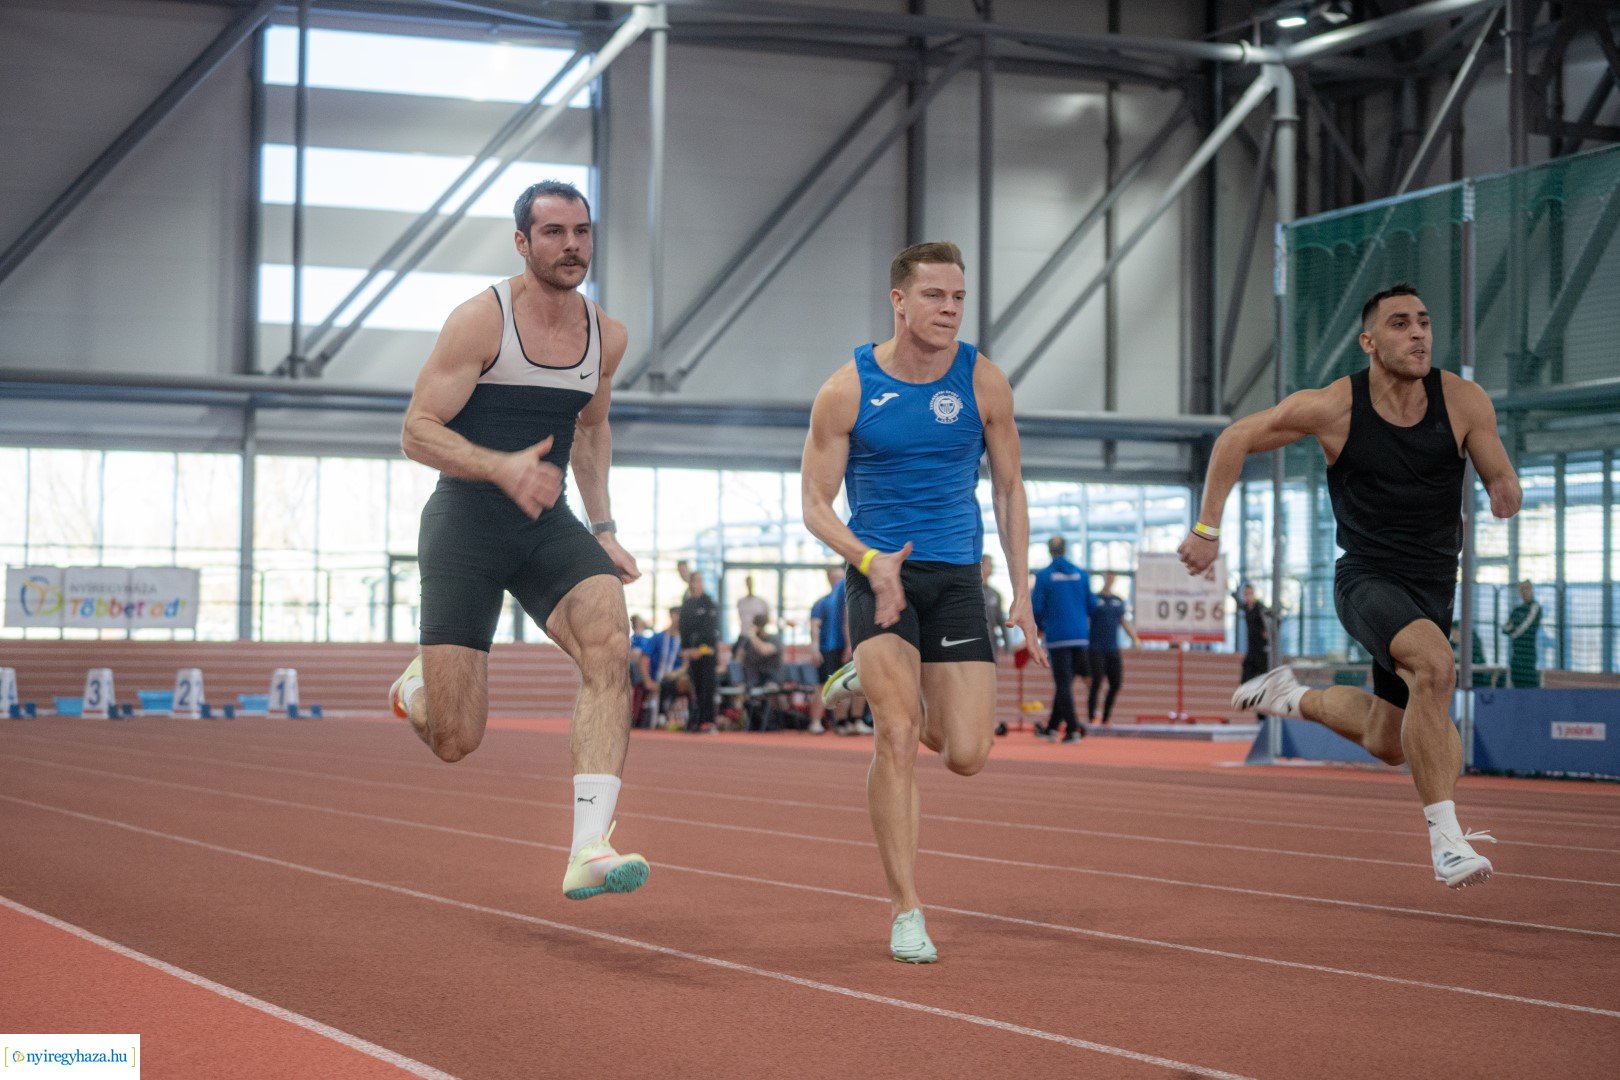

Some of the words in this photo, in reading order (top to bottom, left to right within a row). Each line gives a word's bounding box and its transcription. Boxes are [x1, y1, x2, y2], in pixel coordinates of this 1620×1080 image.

[88, 679, 101, 706] 3
[178, 679, 191, 706] 2
[275, 680, 286, 706] 1
